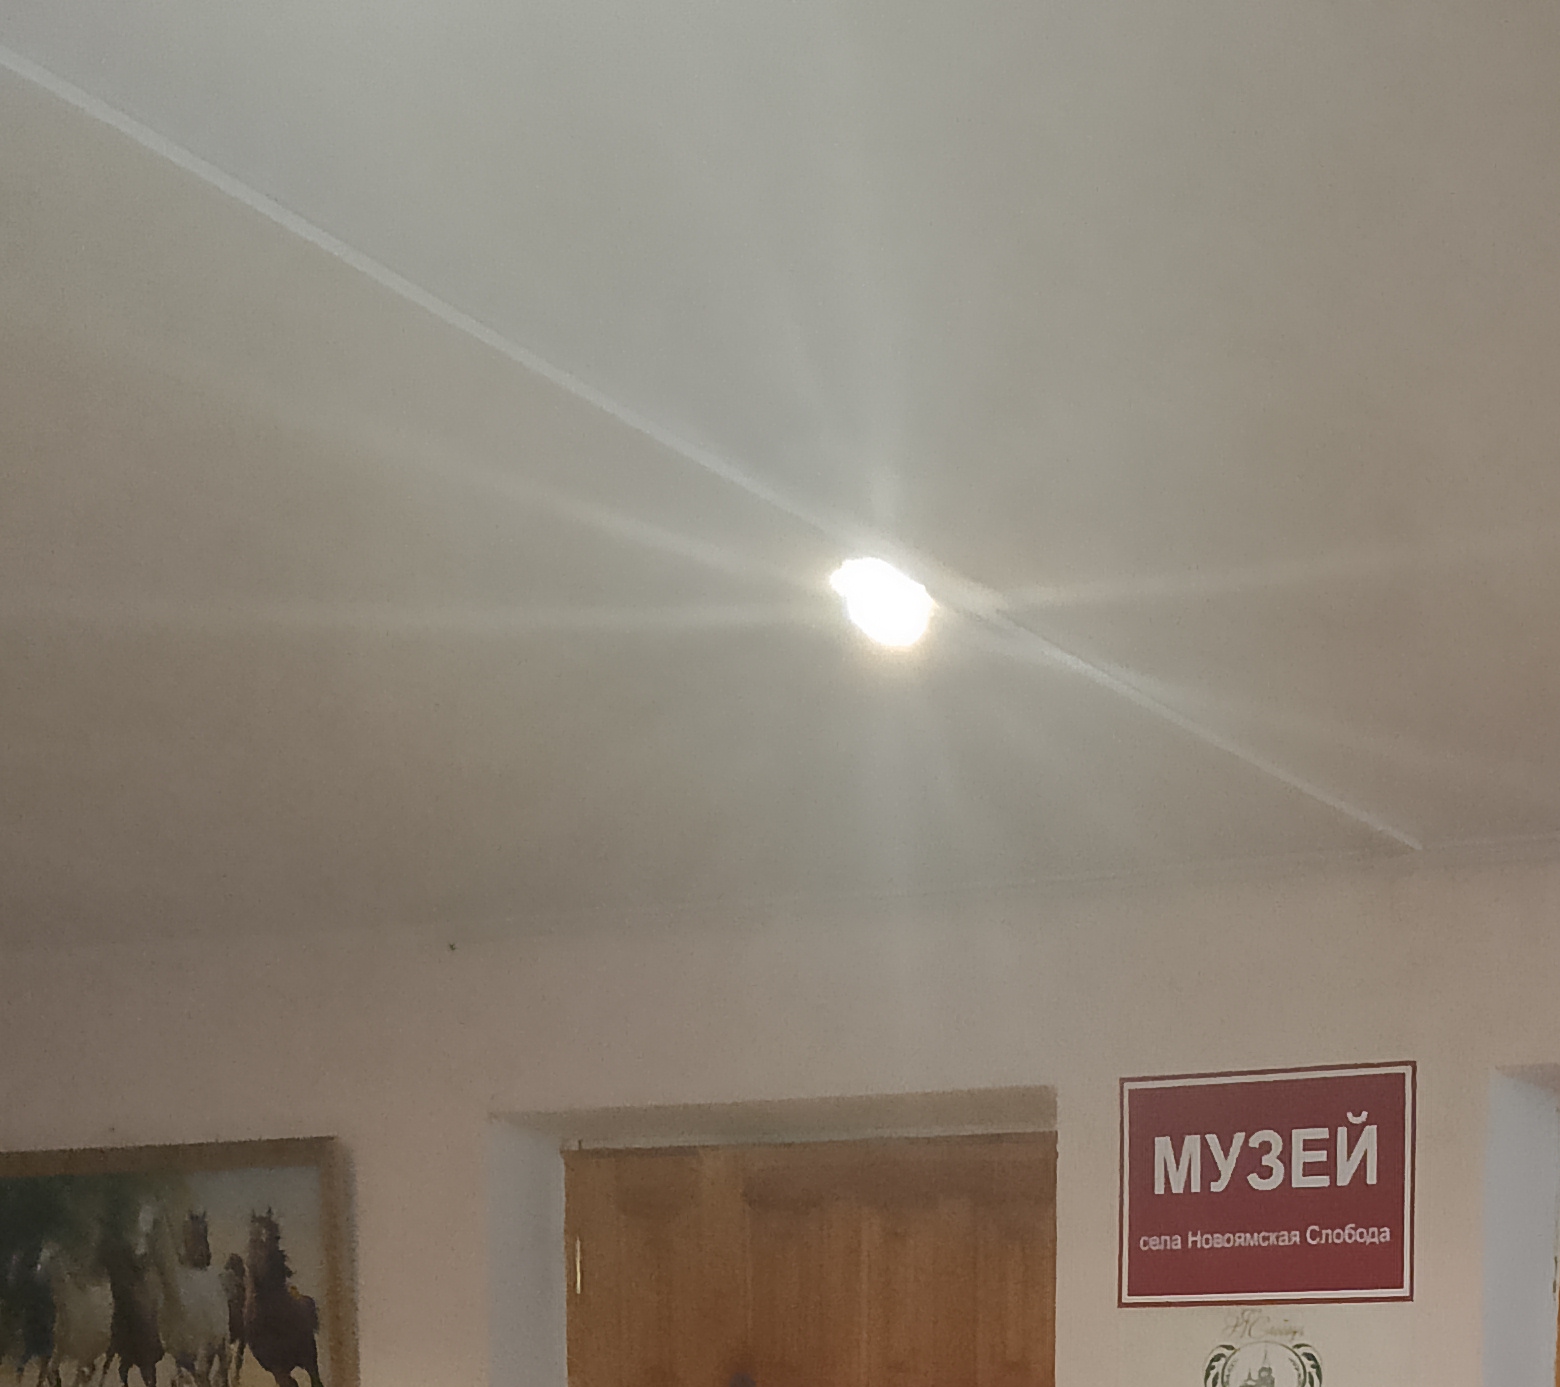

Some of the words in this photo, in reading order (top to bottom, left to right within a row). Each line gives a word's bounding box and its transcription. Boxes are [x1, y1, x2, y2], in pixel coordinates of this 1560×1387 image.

[1154, 1110, 1378, 1195] МУЗЕЙ
[1139, 1234, 1182, 1251] села
[1187, 1230, 1300, 1249] Новоямская
[1306, 1224, 1391, 1246] Слобода
